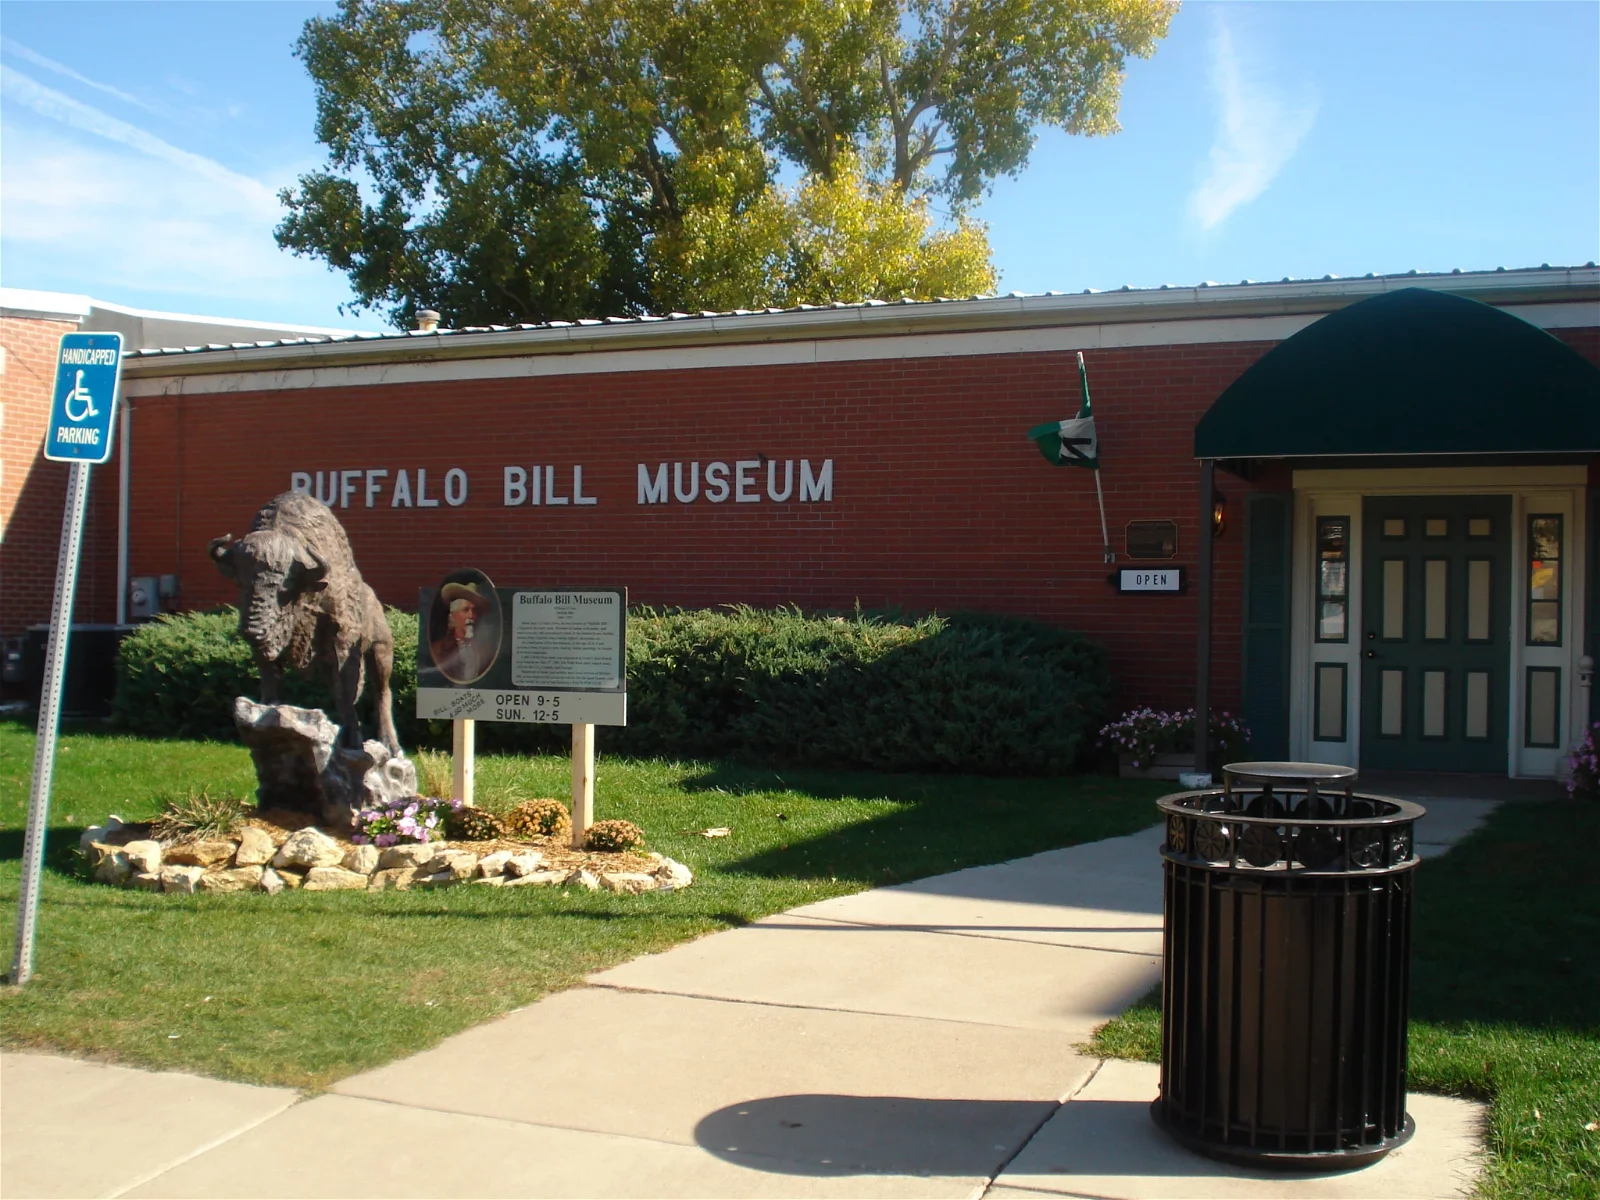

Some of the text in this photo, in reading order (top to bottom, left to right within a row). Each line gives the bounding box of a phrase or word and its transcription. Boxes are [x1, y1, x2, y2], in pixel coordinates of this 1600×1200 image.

[61, 348, 116, 366] HANDICAPPED
[57, 426, 100, 445] PARKING
[504, 465, 598, 507] BILL
[637, 458, 834, 504] MUSEUM
[1136, 574, 1167, 586] OPEN
[520, 595, 613, 605] Buffalo Bill Museum
[461, 692, 482, 709] MUCH
[466, 698, 486, 714] MORE
[495, 694, 560, 708] OPEN 9-5
[496, 708, 560, 722] SUN. 12-5
